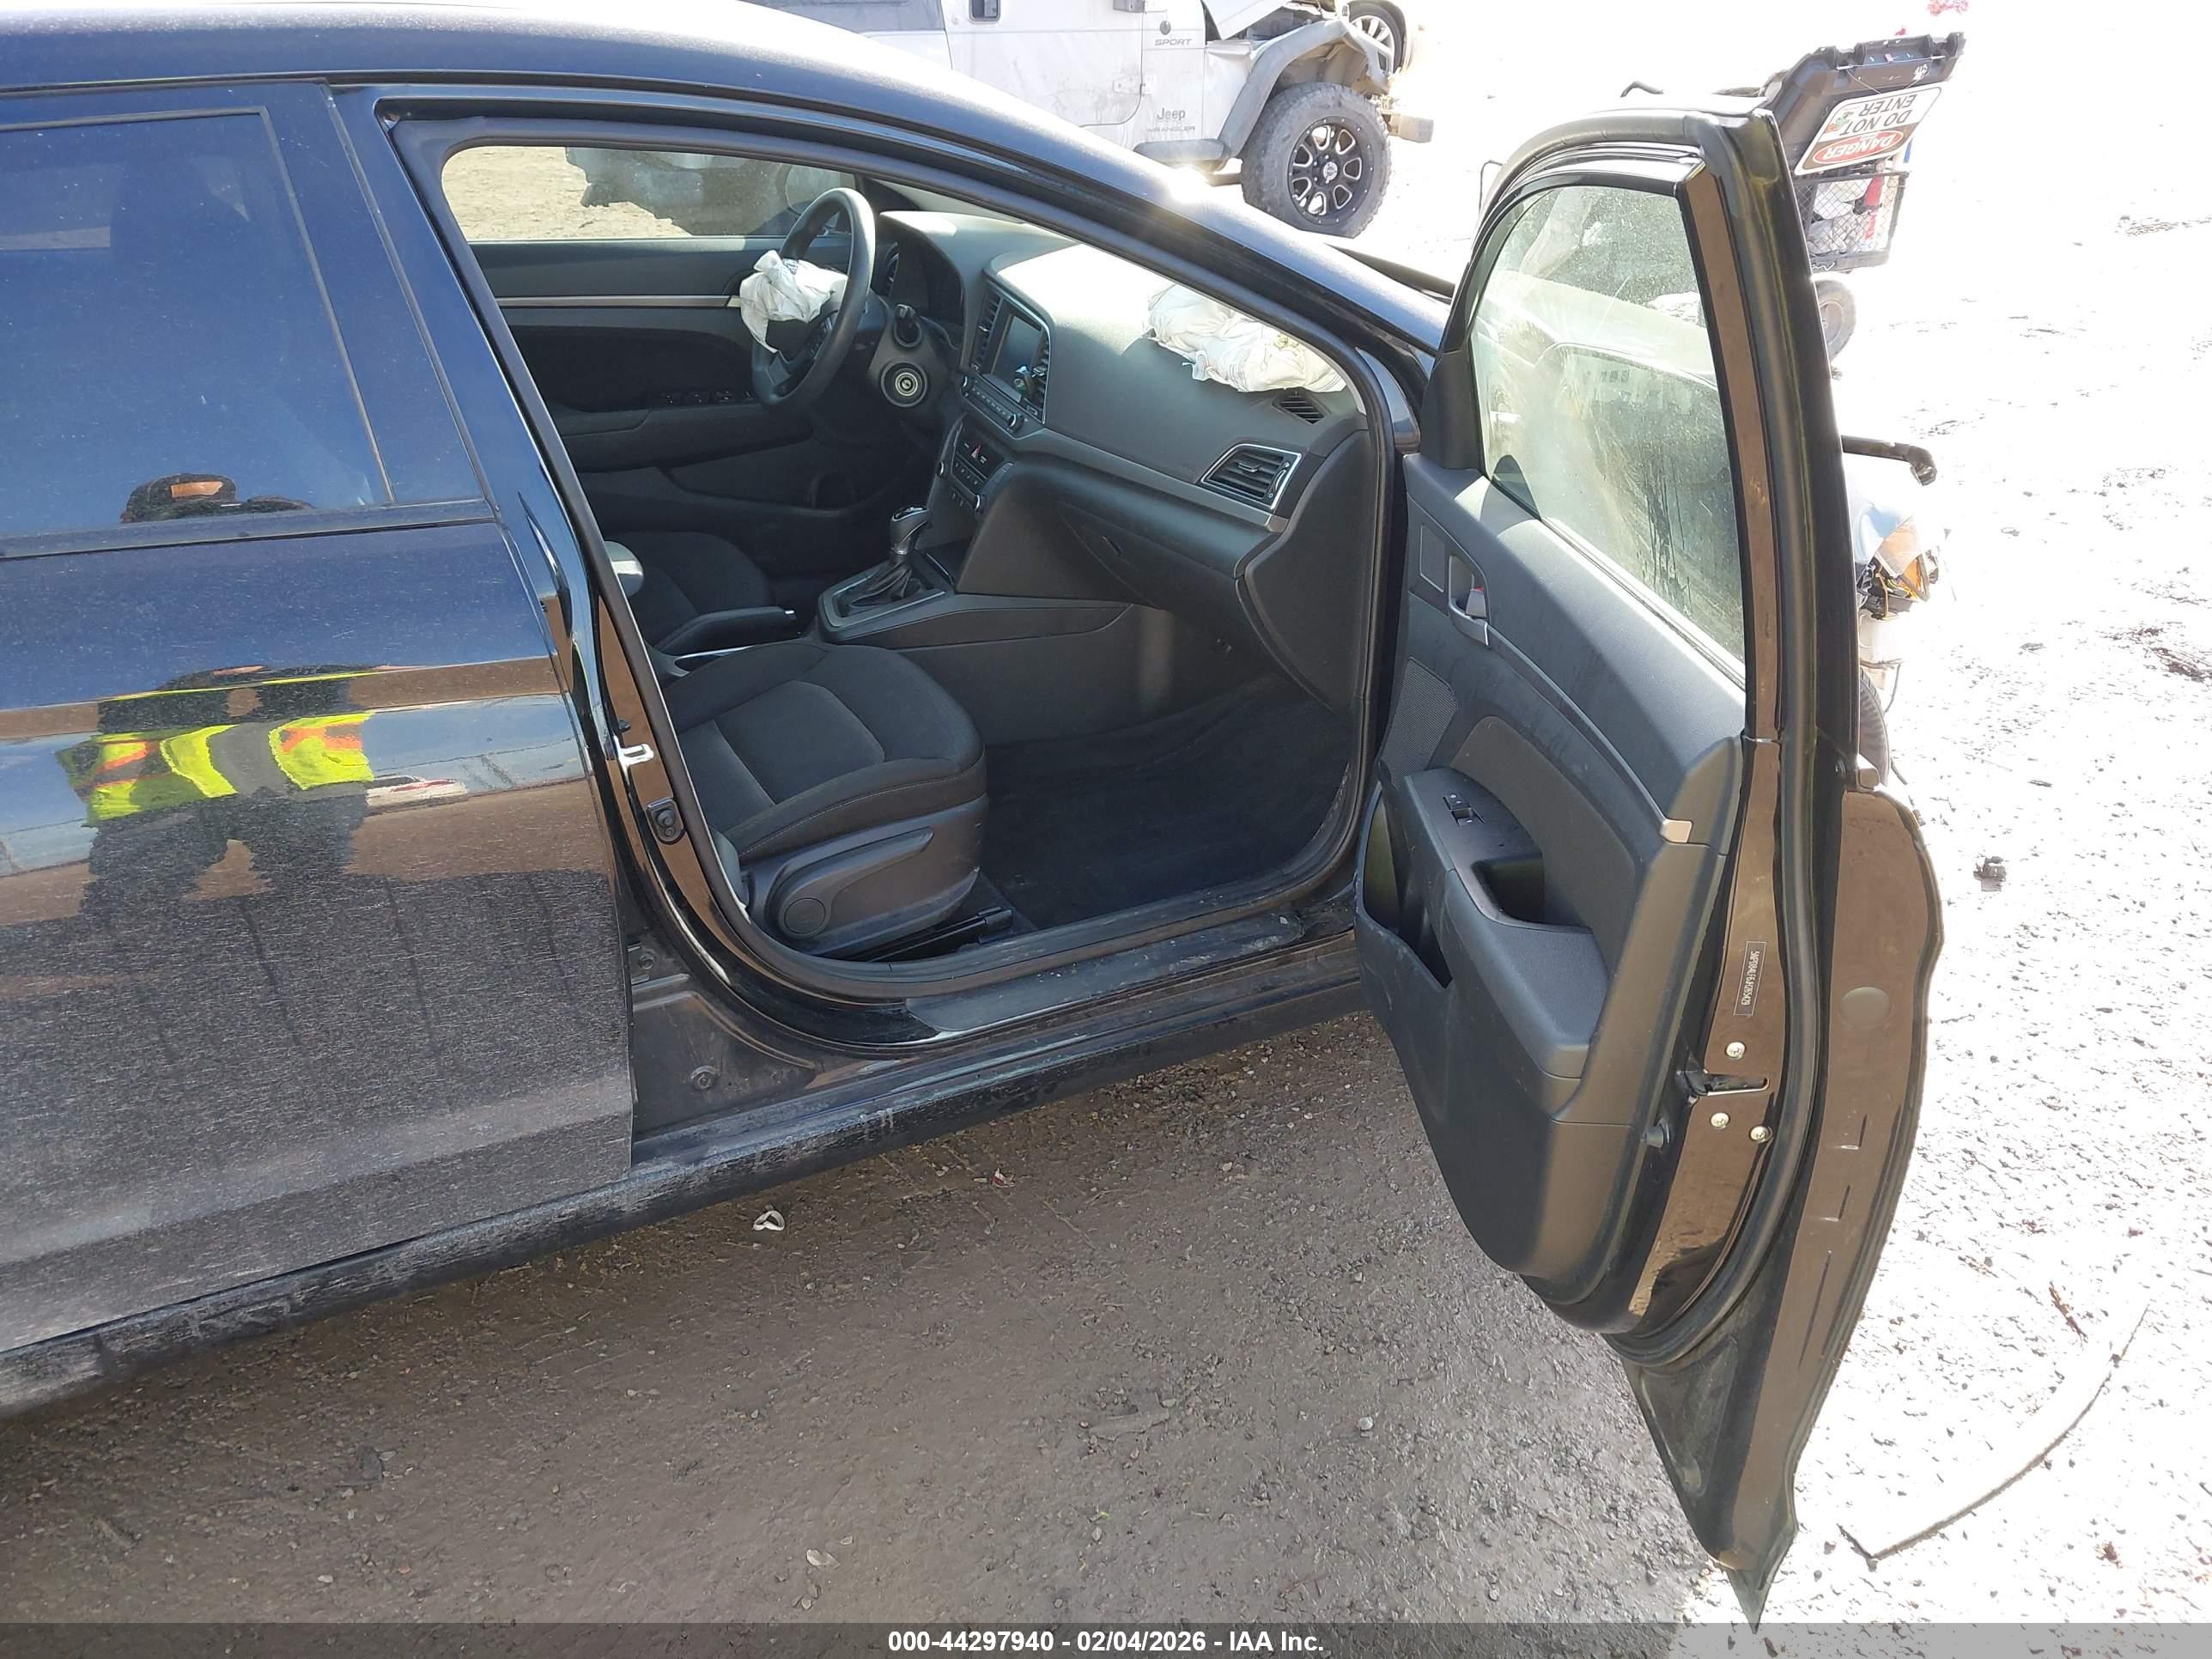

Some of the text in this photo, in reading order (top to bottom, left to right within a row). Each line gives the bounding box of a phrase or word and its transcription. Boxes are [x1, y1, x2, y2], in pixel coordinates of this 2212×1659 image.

[1154, 38, 1193, 46] SPORT
[1157, 107, 1186, 121] Jeep
[1858, 94, 1917, 118] ENTER
[1840, 109, 1913, 137] DO NOT
[1822, 132, 1898, 161] DANGER
